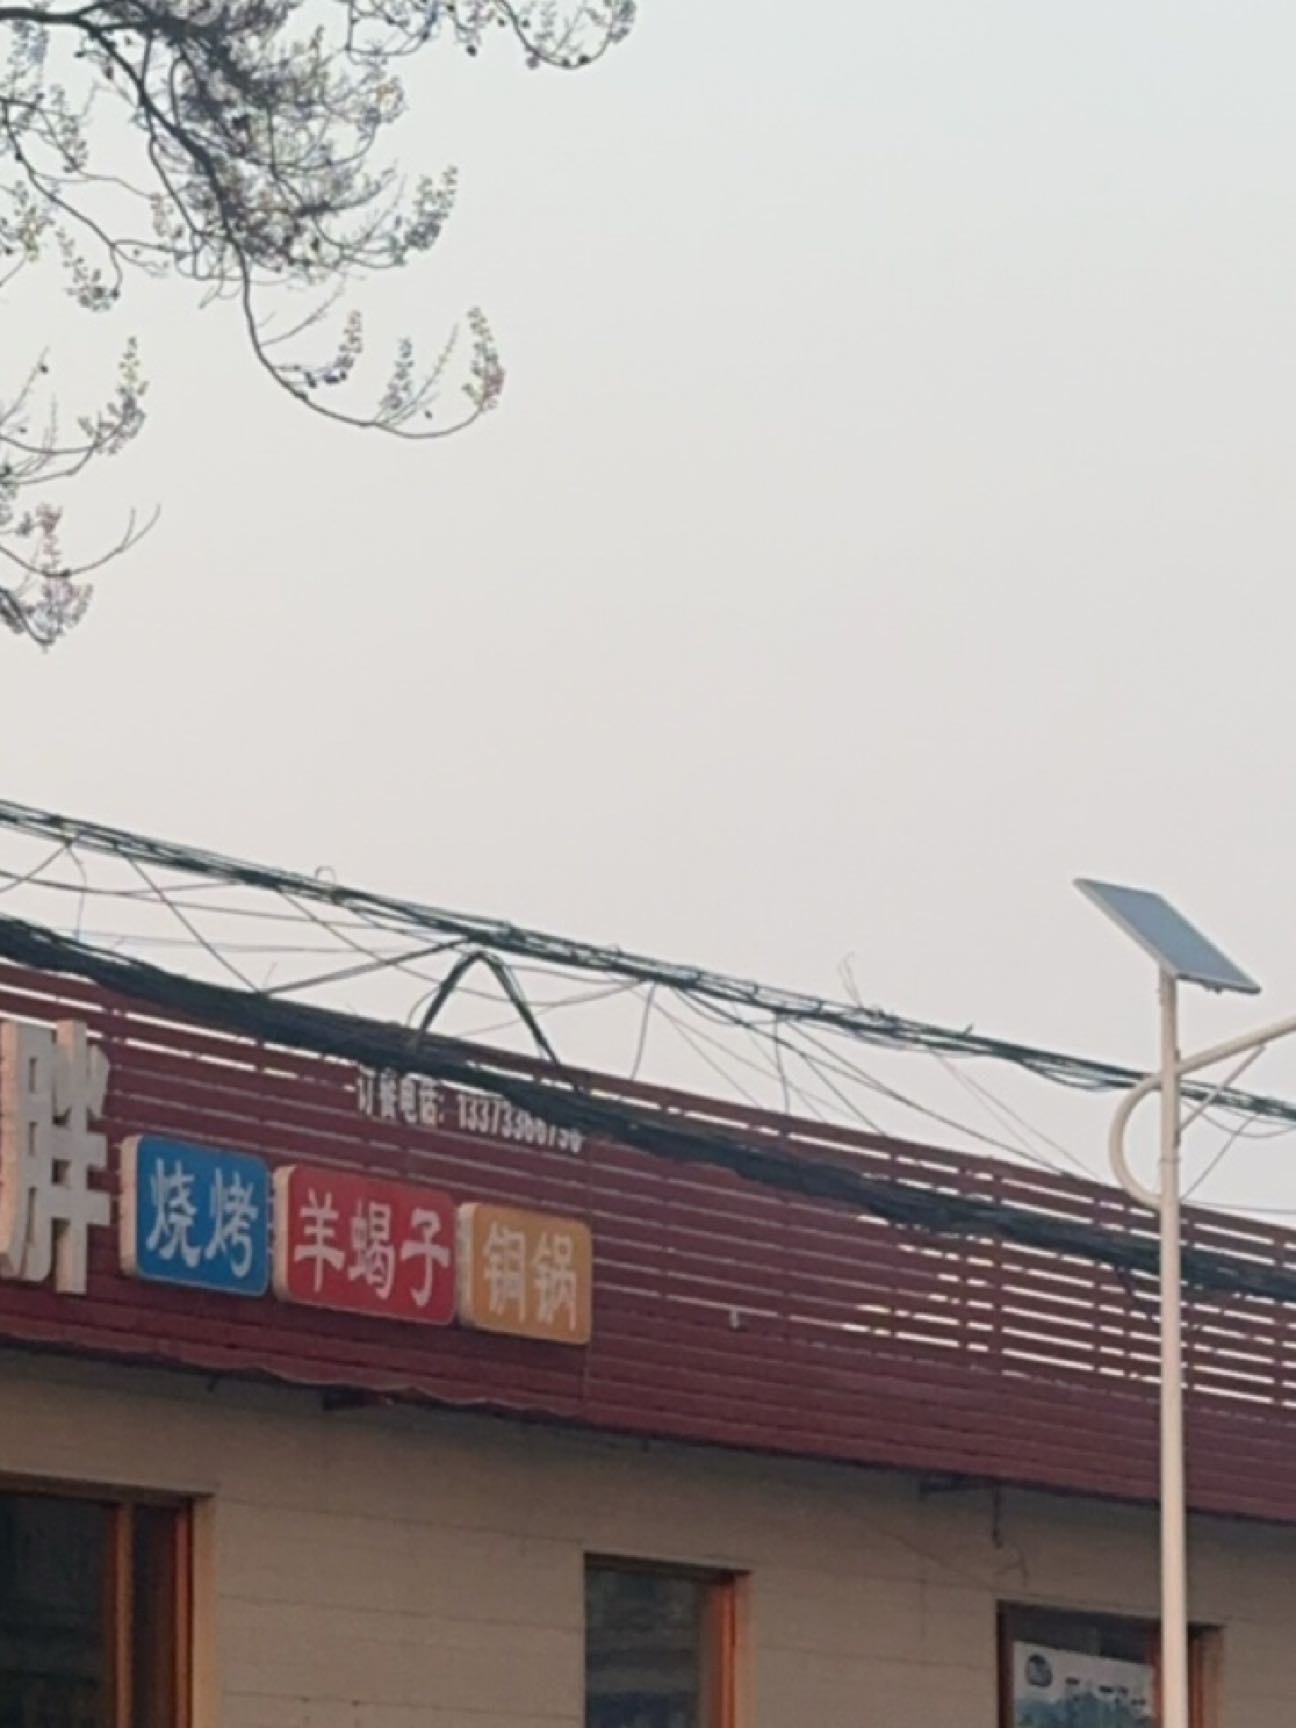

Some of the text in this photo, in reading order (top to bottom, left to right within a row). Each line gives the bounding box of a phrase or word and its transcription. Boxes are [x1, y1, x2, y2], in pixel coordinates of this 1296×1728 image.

[145, 1158, 258, 1278] 烧烤
[294, 1190, 451, 1306] 羊蝎子
